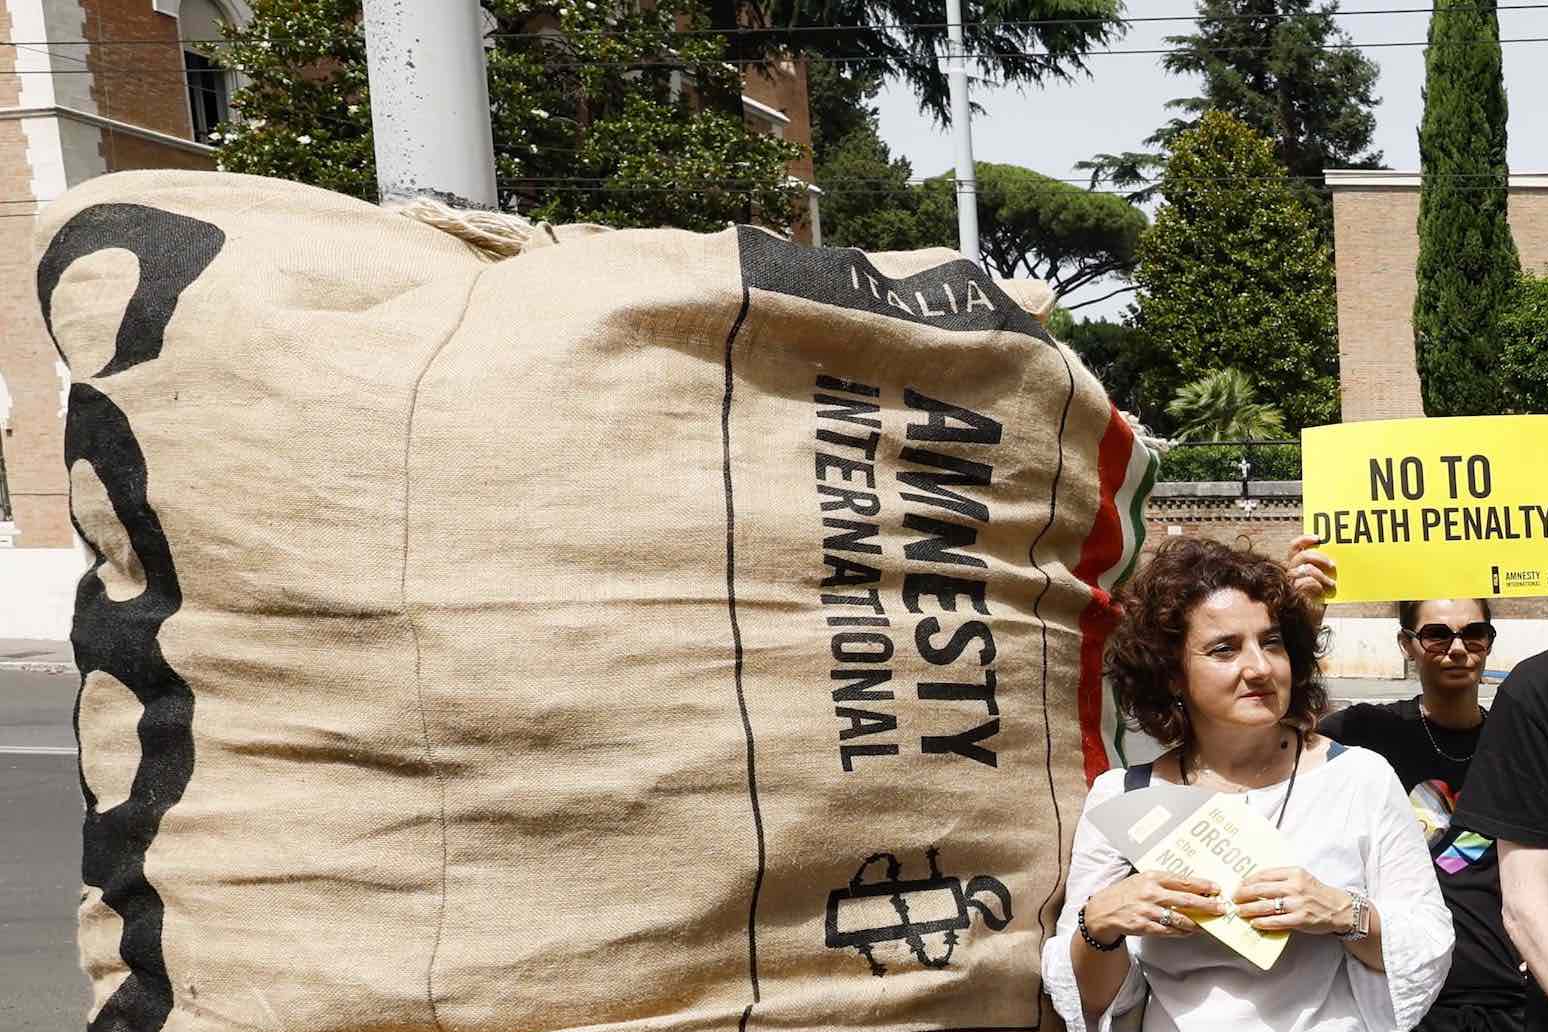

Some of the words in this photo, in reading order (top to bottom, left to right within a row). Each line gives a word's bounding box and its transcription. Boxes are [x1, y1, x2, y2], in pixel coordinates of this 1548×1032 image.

[851, 265, 996, 317] ITALIA
[1368, 456, 1426, 501] NO
[1439, 454, 1493, 500] TO
[1313, 507, 1411, 545] DEATH
[813, 374, 900, 773] INTERNATIONAL
[896, 387, 1003, 769] AMNESTY
[1505, 570, 1541, 581] AMNESTY
